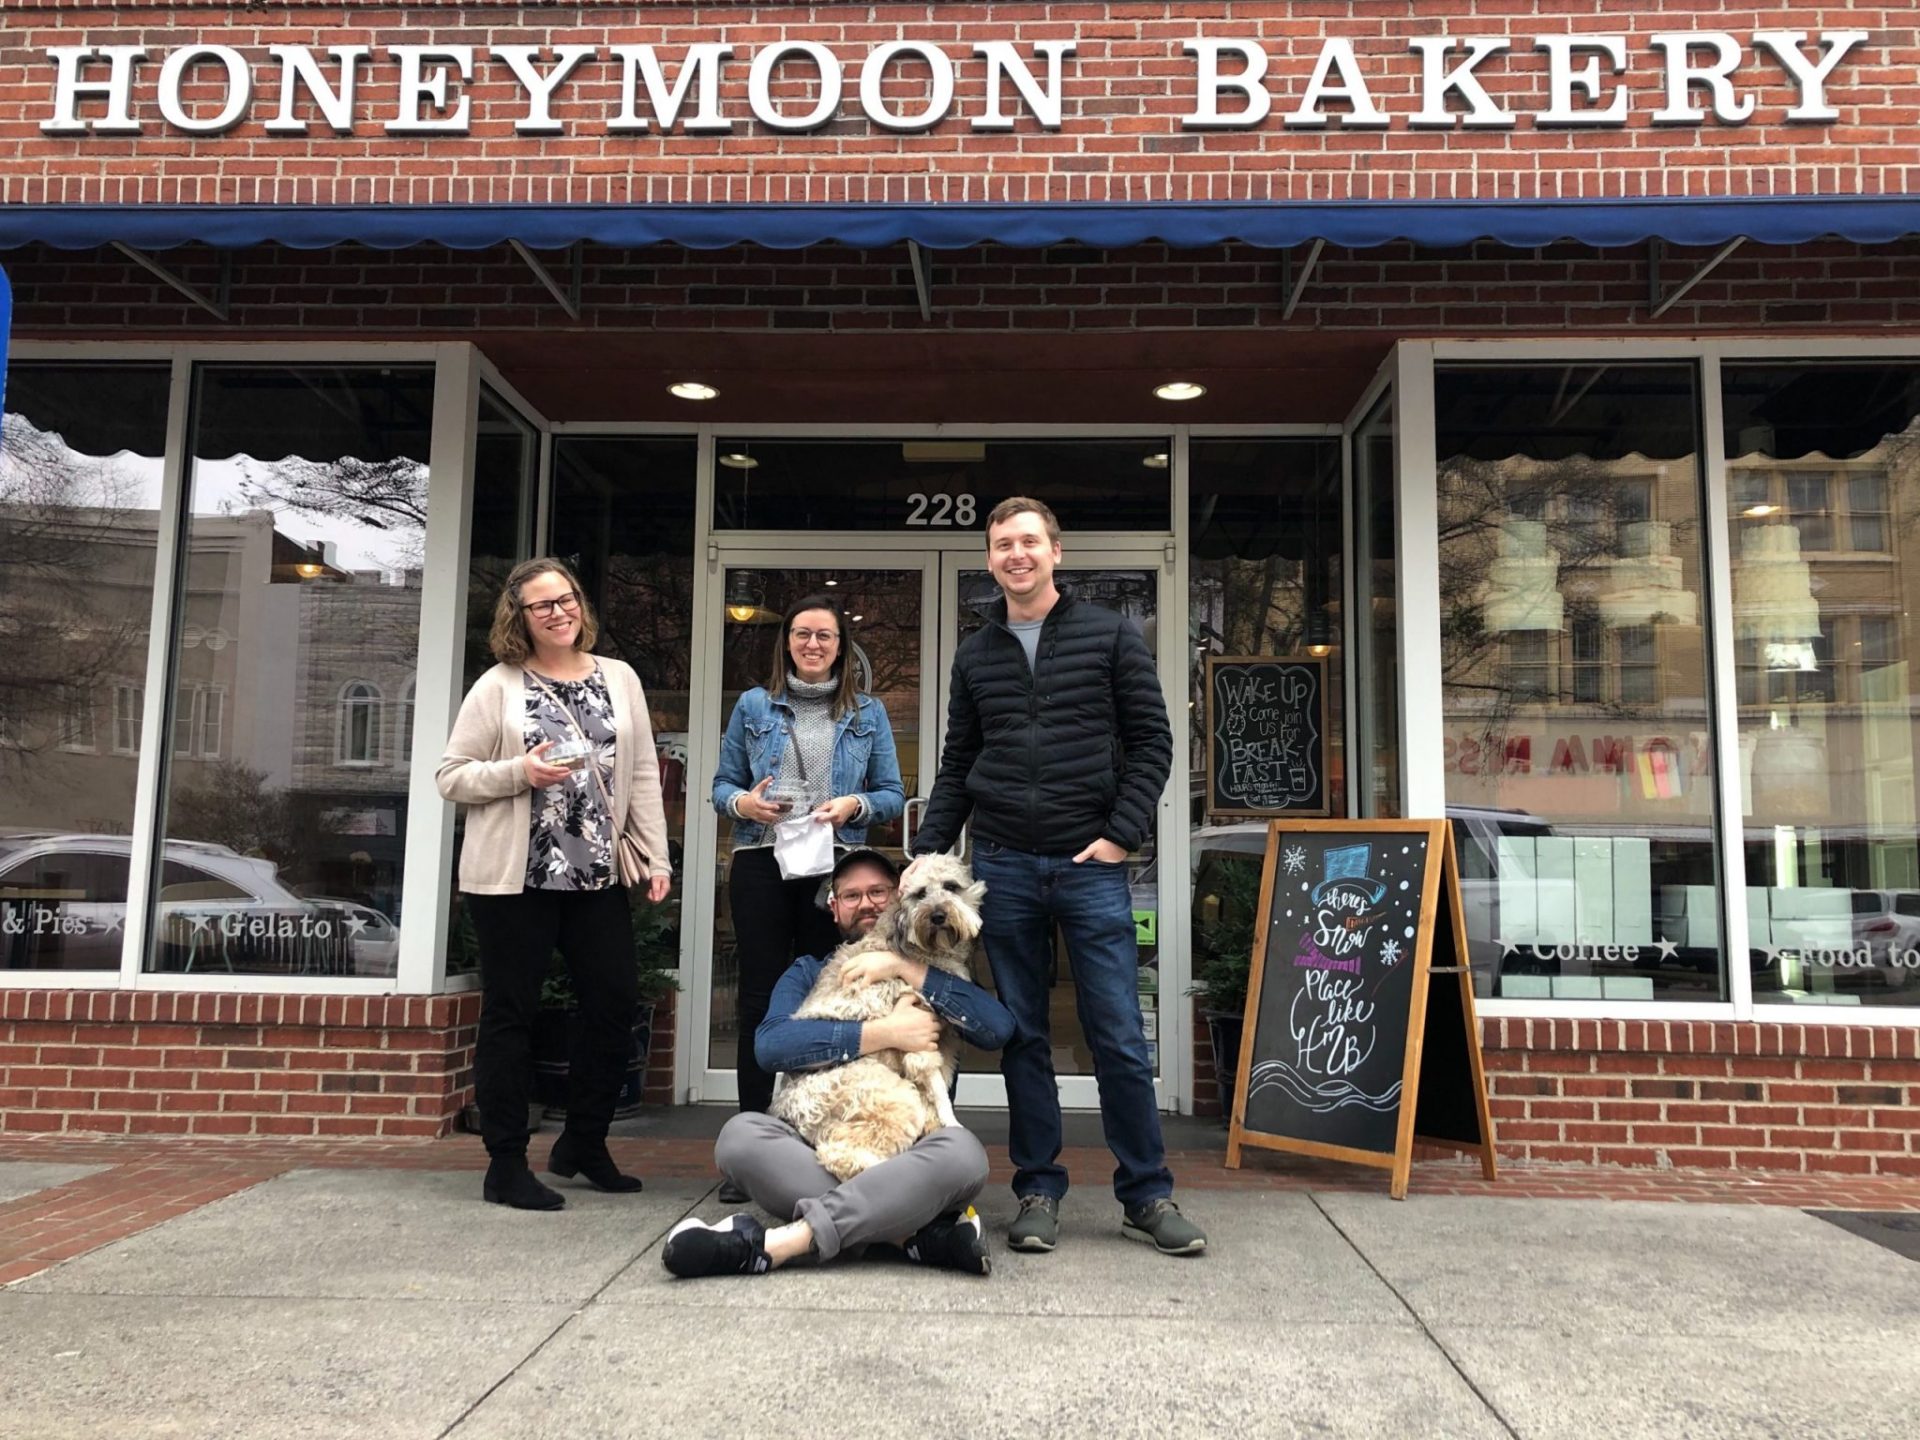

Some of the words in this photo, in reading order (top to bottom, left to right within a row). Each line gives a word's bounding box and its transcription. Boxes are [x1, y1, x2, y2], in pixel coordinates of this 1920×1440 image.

[39, 40, 1077, 136] HONEYMOON
[1181, 31, 1868, 131] BAKERY
[905, 493, 977, 526] 228
[1222, 676, 1277, 705] WAKE
[1281, 676, 1307, 709] UP
[1249, 707, 1280, 721] Come
[1232, 761, 1288, 783] FAST
[2, 907, 25, 934] &
[33, 908, 87, 935] Pies
[220, 911, 332, 939] Gelato
[1313, 909, 1373, 955] Snow
[1305, 969, 1365, 1001] Place
[1320, 998, 1375, 1028] like
